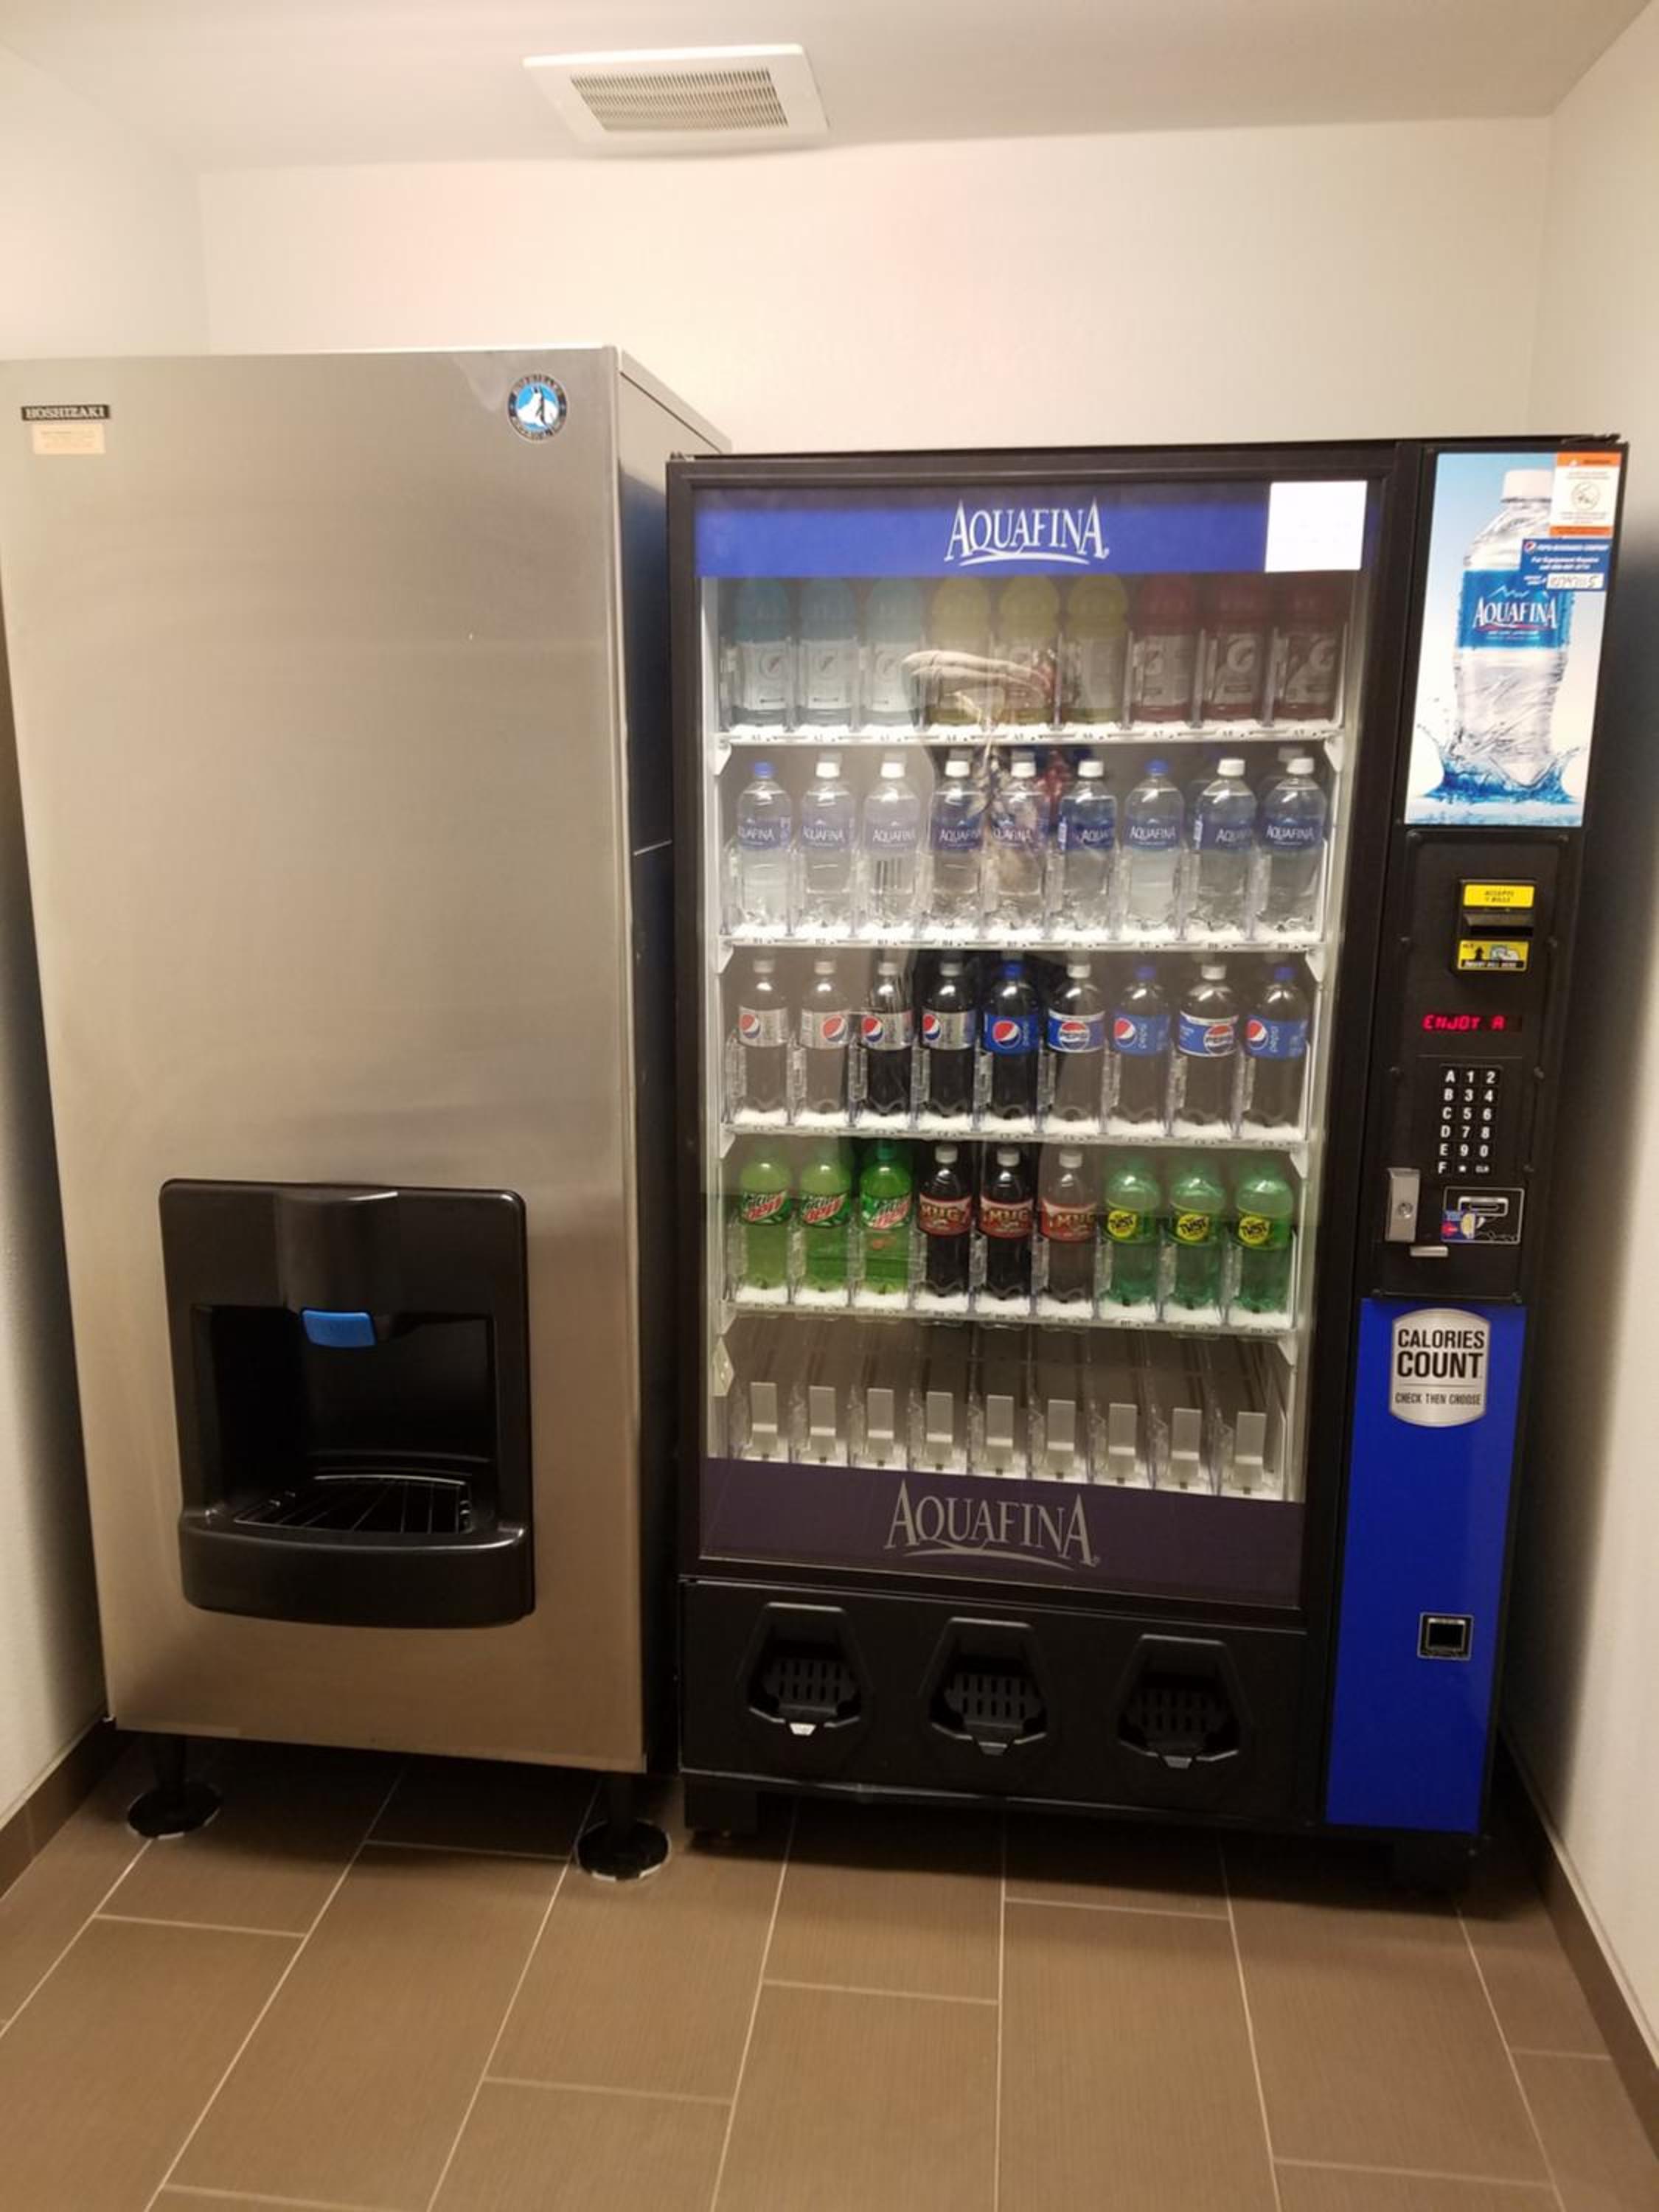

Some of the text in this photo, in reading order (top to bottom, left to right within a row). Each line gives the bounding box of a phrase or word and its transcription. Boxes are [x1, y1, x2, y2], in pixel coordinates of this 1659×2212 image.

[26, 407, 105, 419] HOSHIZAKI
[944, 498, 1105, 564] AQUAFINA
[1472, 597, 1557, 629] AQUAFINA
[1130, 825, 1178, 842] AQUAFINA
[1266, 824, 1315, 843] AQUAFINA
[1422, 1014, 1481, 1030] ENJOY
[1444, 1069, 1495, 1084] A 1 2
[1444, 1088, 1494, 1102] B 3 4
[1442, 1106, 1492, 1121] C 5 6
[1440, 1124, 1490, 1139] D 7 8
[1439, 1143, 1448, 1156] E
[1460, 1144, 1469, 1157] 9
[1438, 1161, 1447, 1174] F
[1397, 1329, 1485, 1349] CALORIES
[1397, 1351, 1484, 1378] COUNT
[1395, 1392, 1481, 1405] CHECK THEN CHOOSE
[884, 1478, 1094, 1571] AQUAFINA
